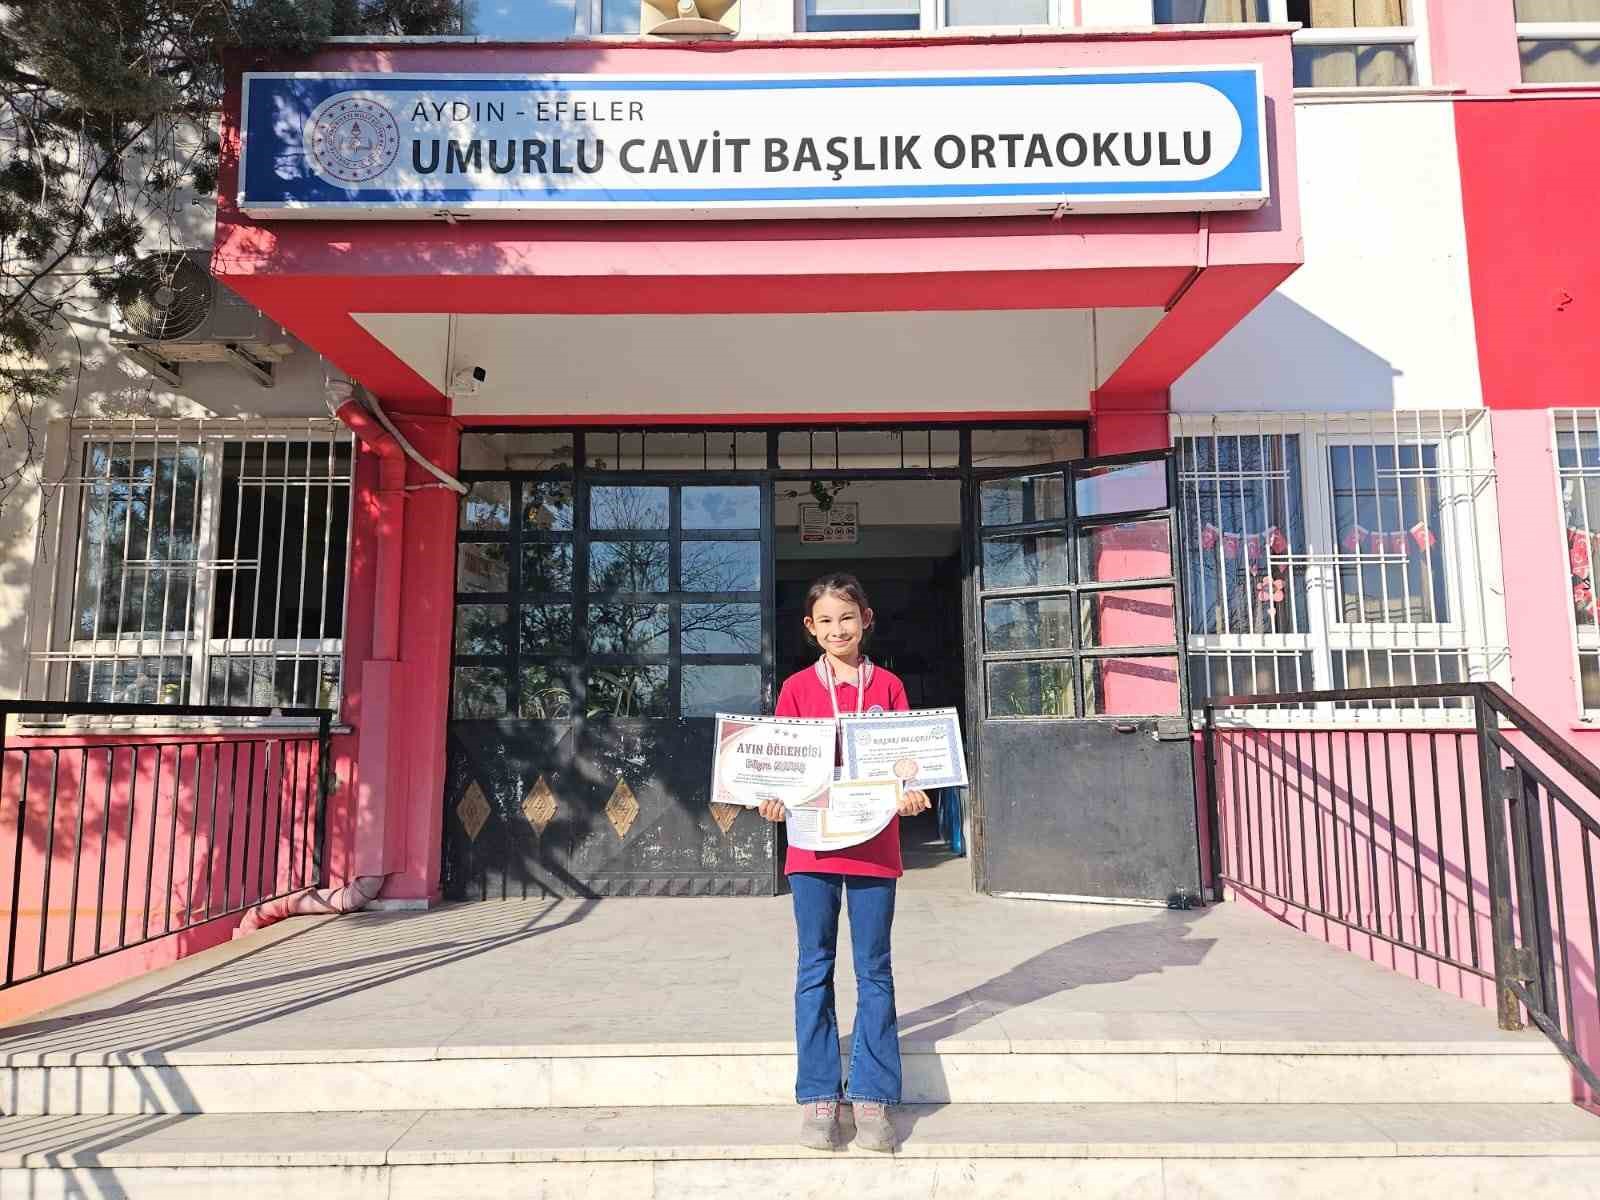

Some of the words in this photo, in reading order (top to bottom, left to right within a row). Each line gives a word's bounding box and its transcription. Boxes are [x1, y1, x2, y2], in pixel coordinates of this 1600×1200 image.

[411, 101, 505, 122] AYDIN
[536, 101, 645, 121] EFELER
[412, 138, 604, 174] UMURLU
[620, 130, 750, 173] CAVİT
[765, 136, 922, 180] BAŞLIK
[933, 131, 1212, 168] ORTAOKULU
[737, 743, 764, 755] AYIN
